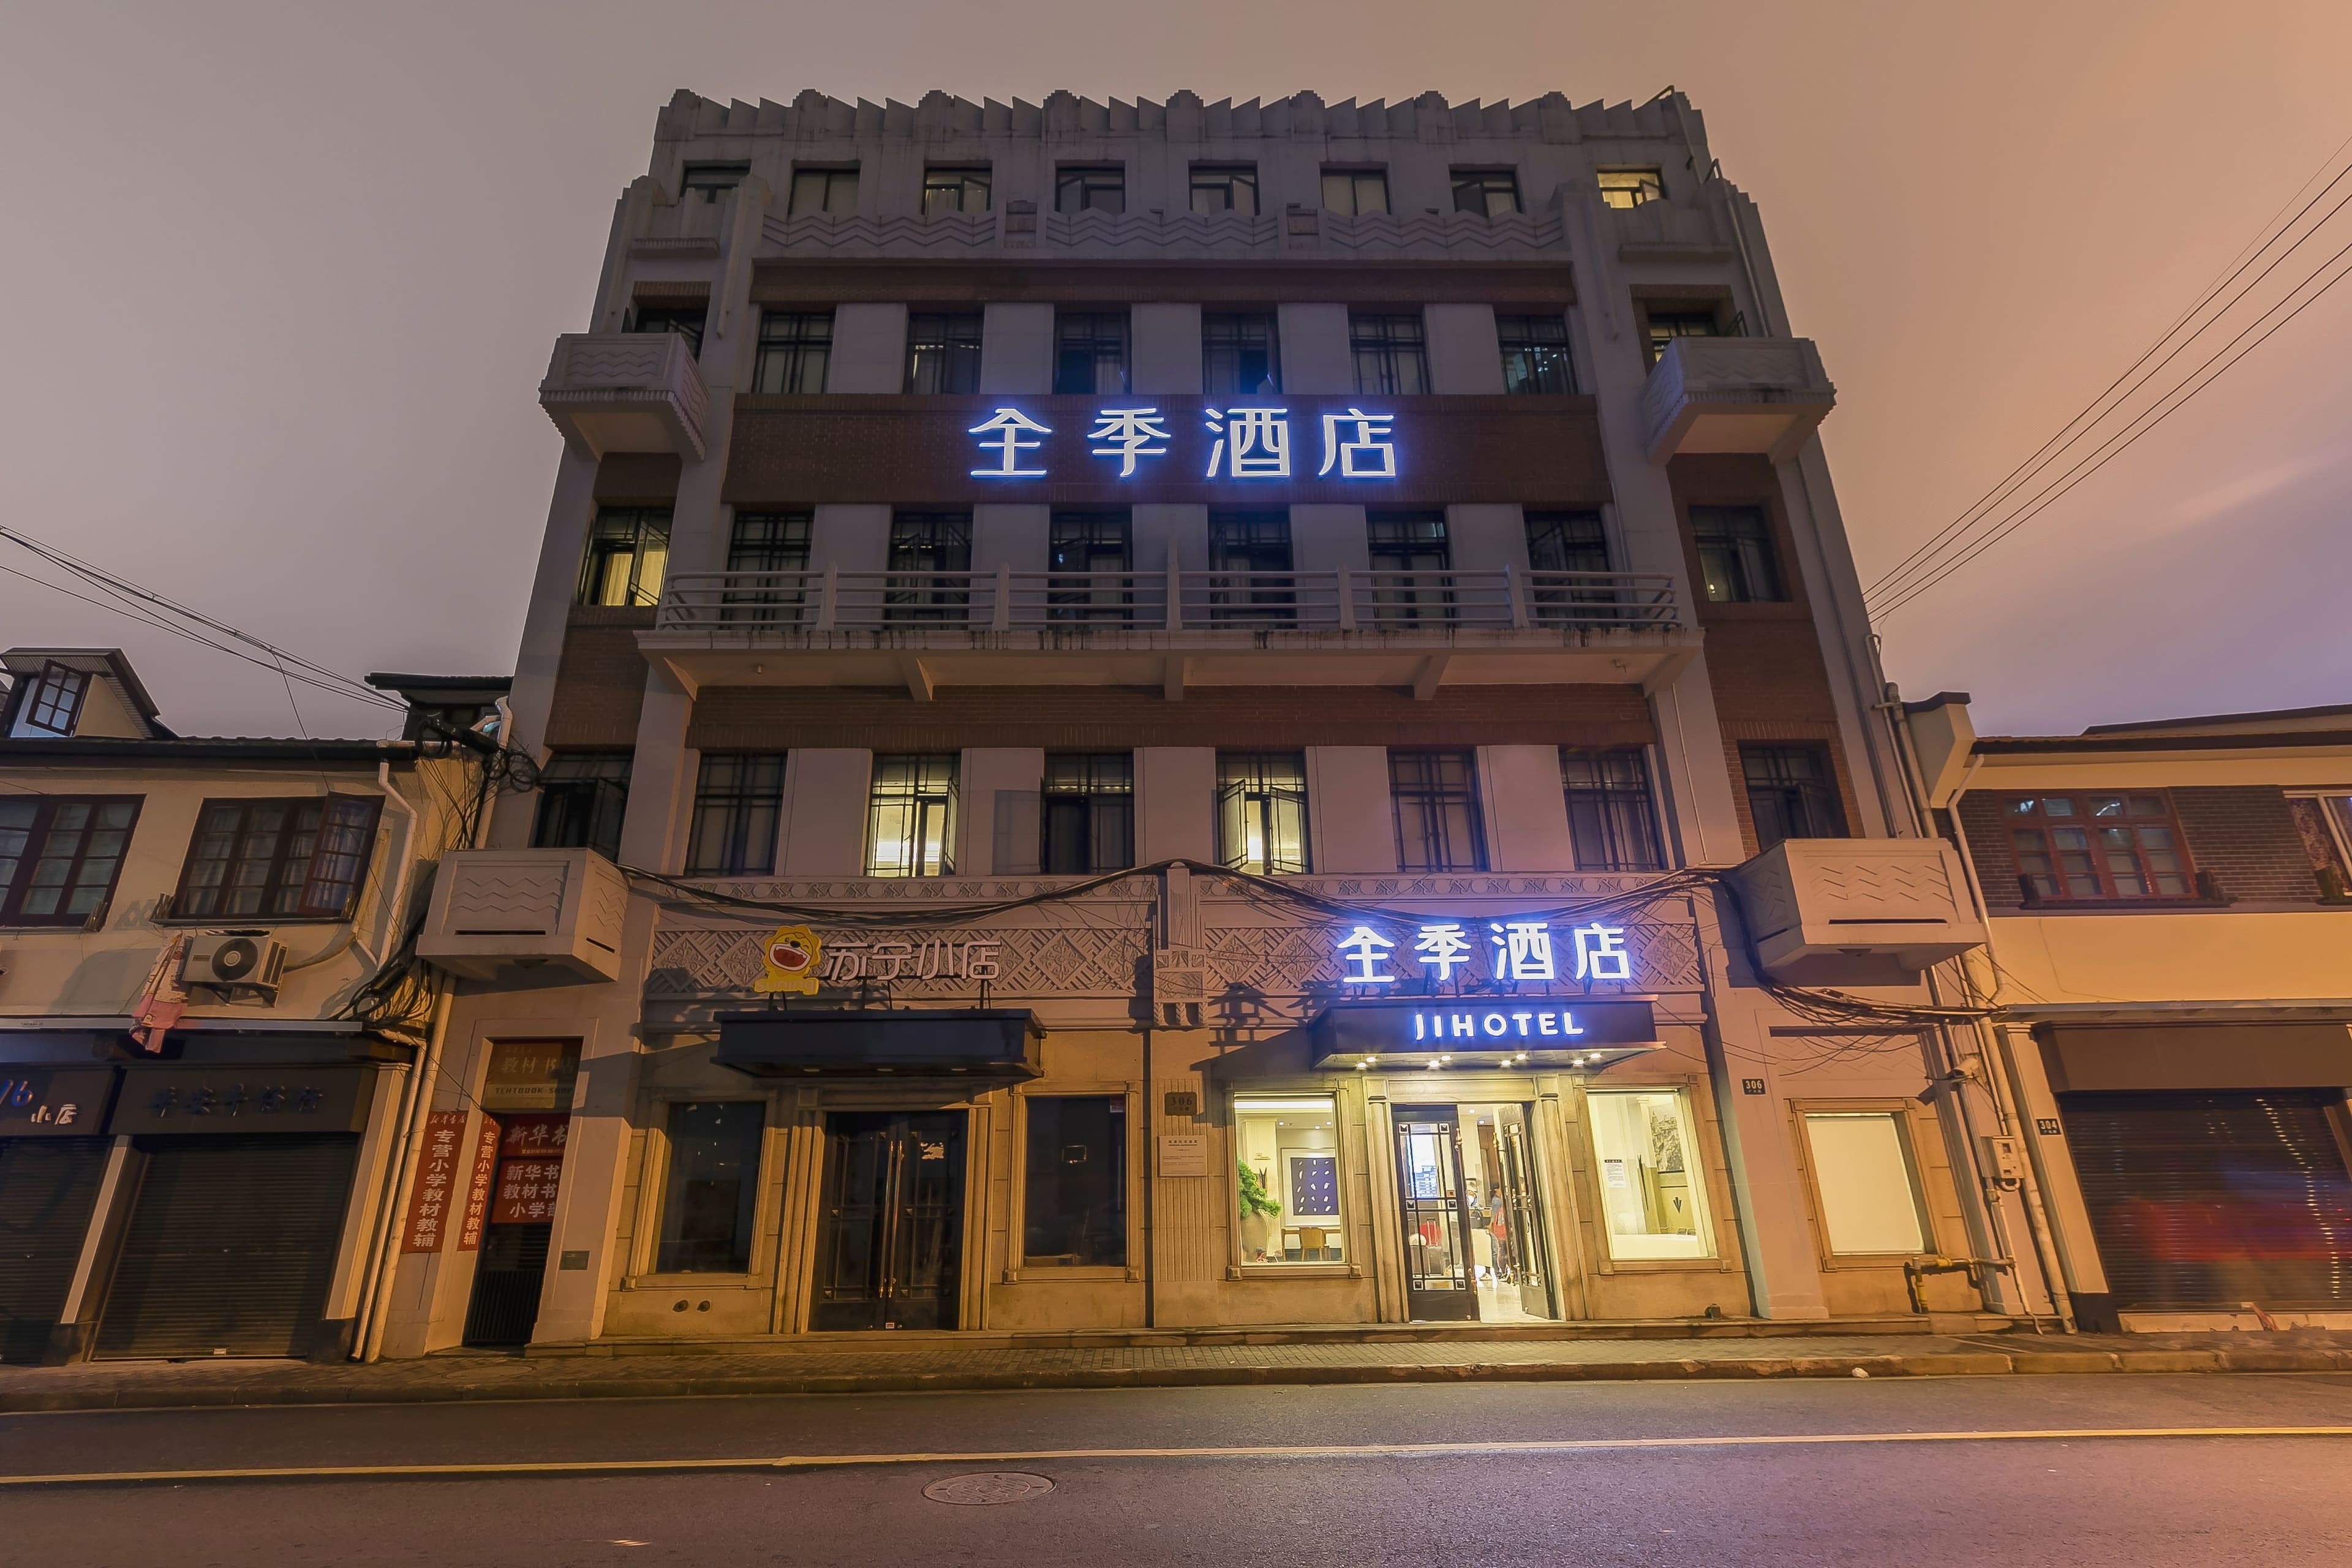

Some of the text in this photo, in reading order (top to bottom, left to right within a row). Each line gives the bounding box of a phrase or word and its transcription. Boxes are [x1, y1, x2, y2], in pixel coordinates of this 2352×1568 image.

[968, 407, 1397, 479] 全季酒店
[826, 939, 1001, 980] 苏宁小店
[1336, 922, 1631, 983] 全季酒店
[756, 978, 815, 993] suning
[1745, 1080, 1762, 1089] 306
[31, 1103, 78, 1126] 小店
[1170, 1096, 1192, 1106] 306
[2039, 1120, 2057, 1129] 304
[413, 1129, 456, 1247] 专营小学教材教辅
[464, 1131, 496, 1245] 专营小学教材教辅
